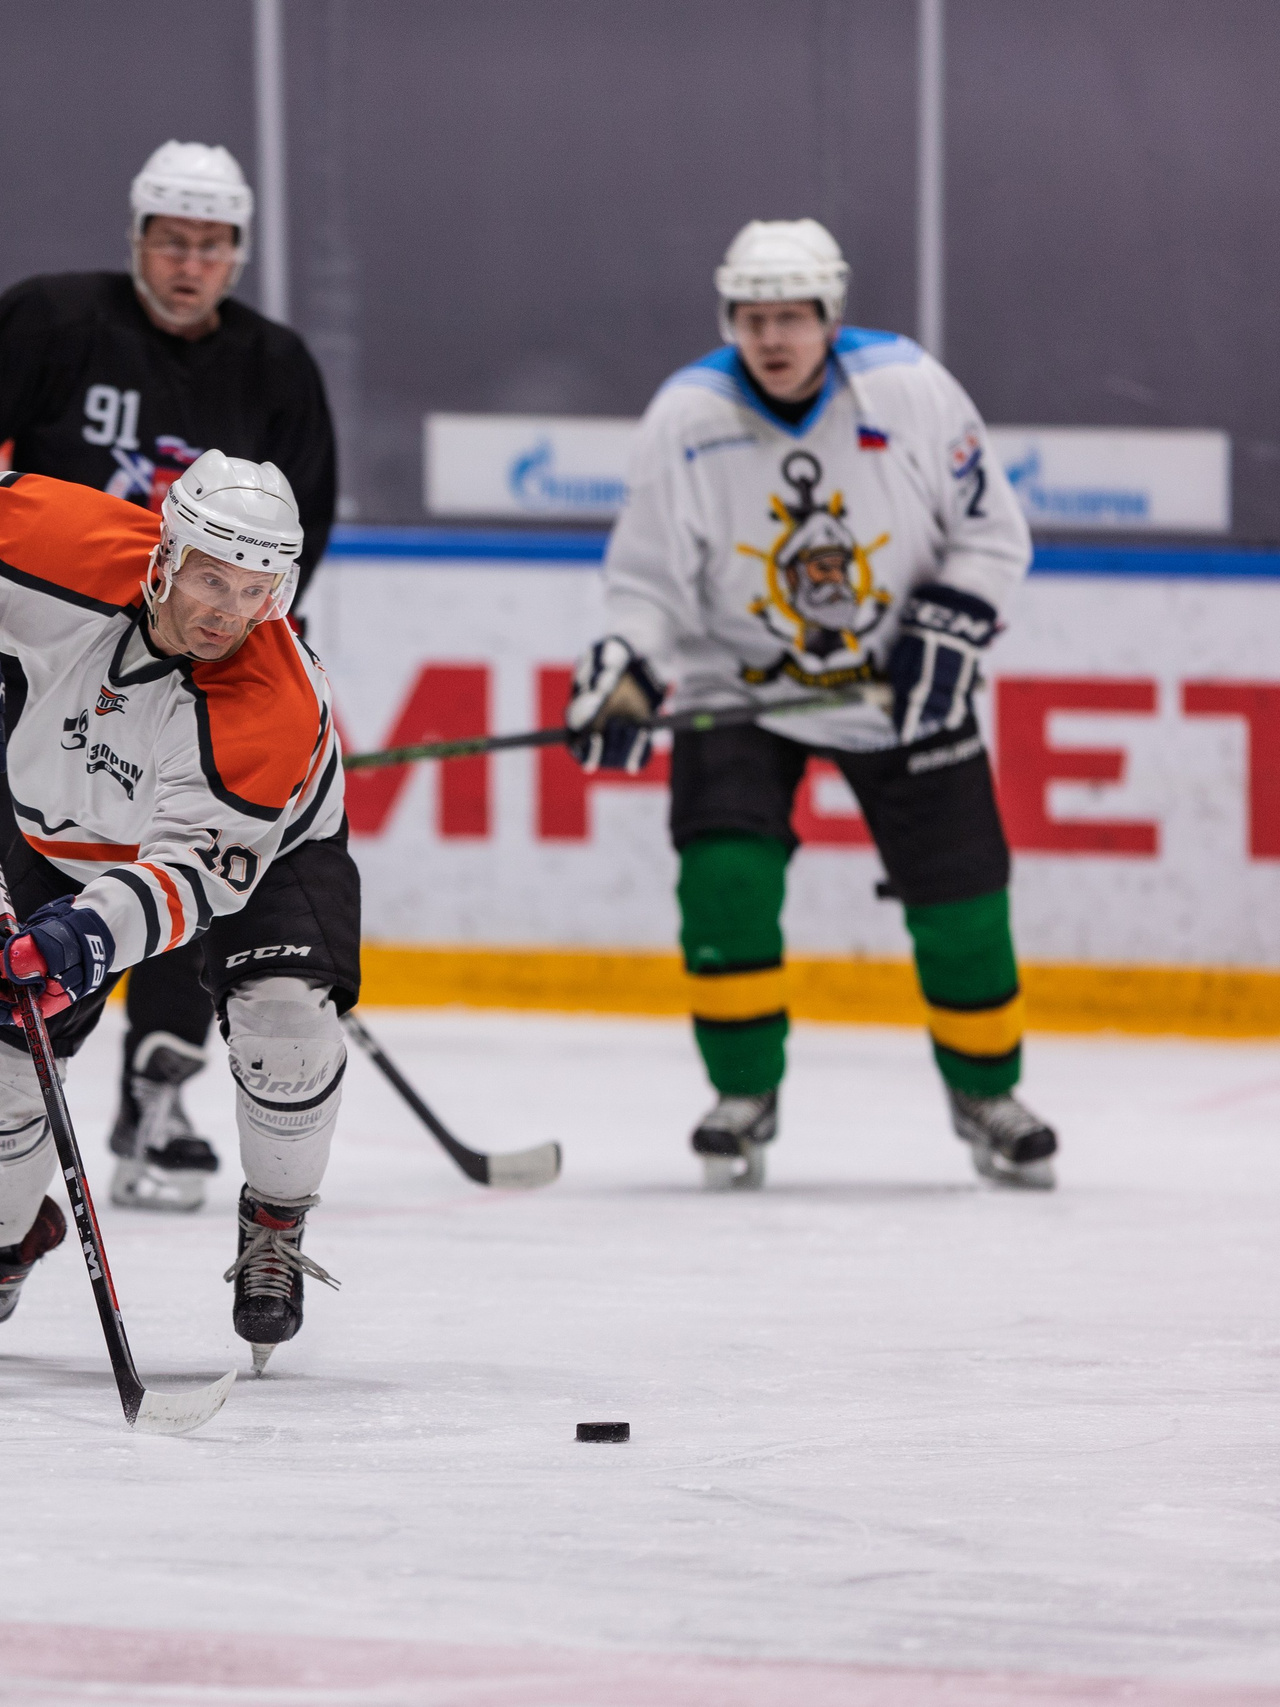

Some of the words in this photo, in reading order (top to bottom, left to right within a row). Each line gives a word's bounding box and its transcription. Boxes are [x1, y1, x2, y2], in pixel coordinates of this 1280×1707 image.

[81, 384, 141, 450] 91
[236, 534, 279, 550] BAUER
[225, 944, 312, 969] CCM
